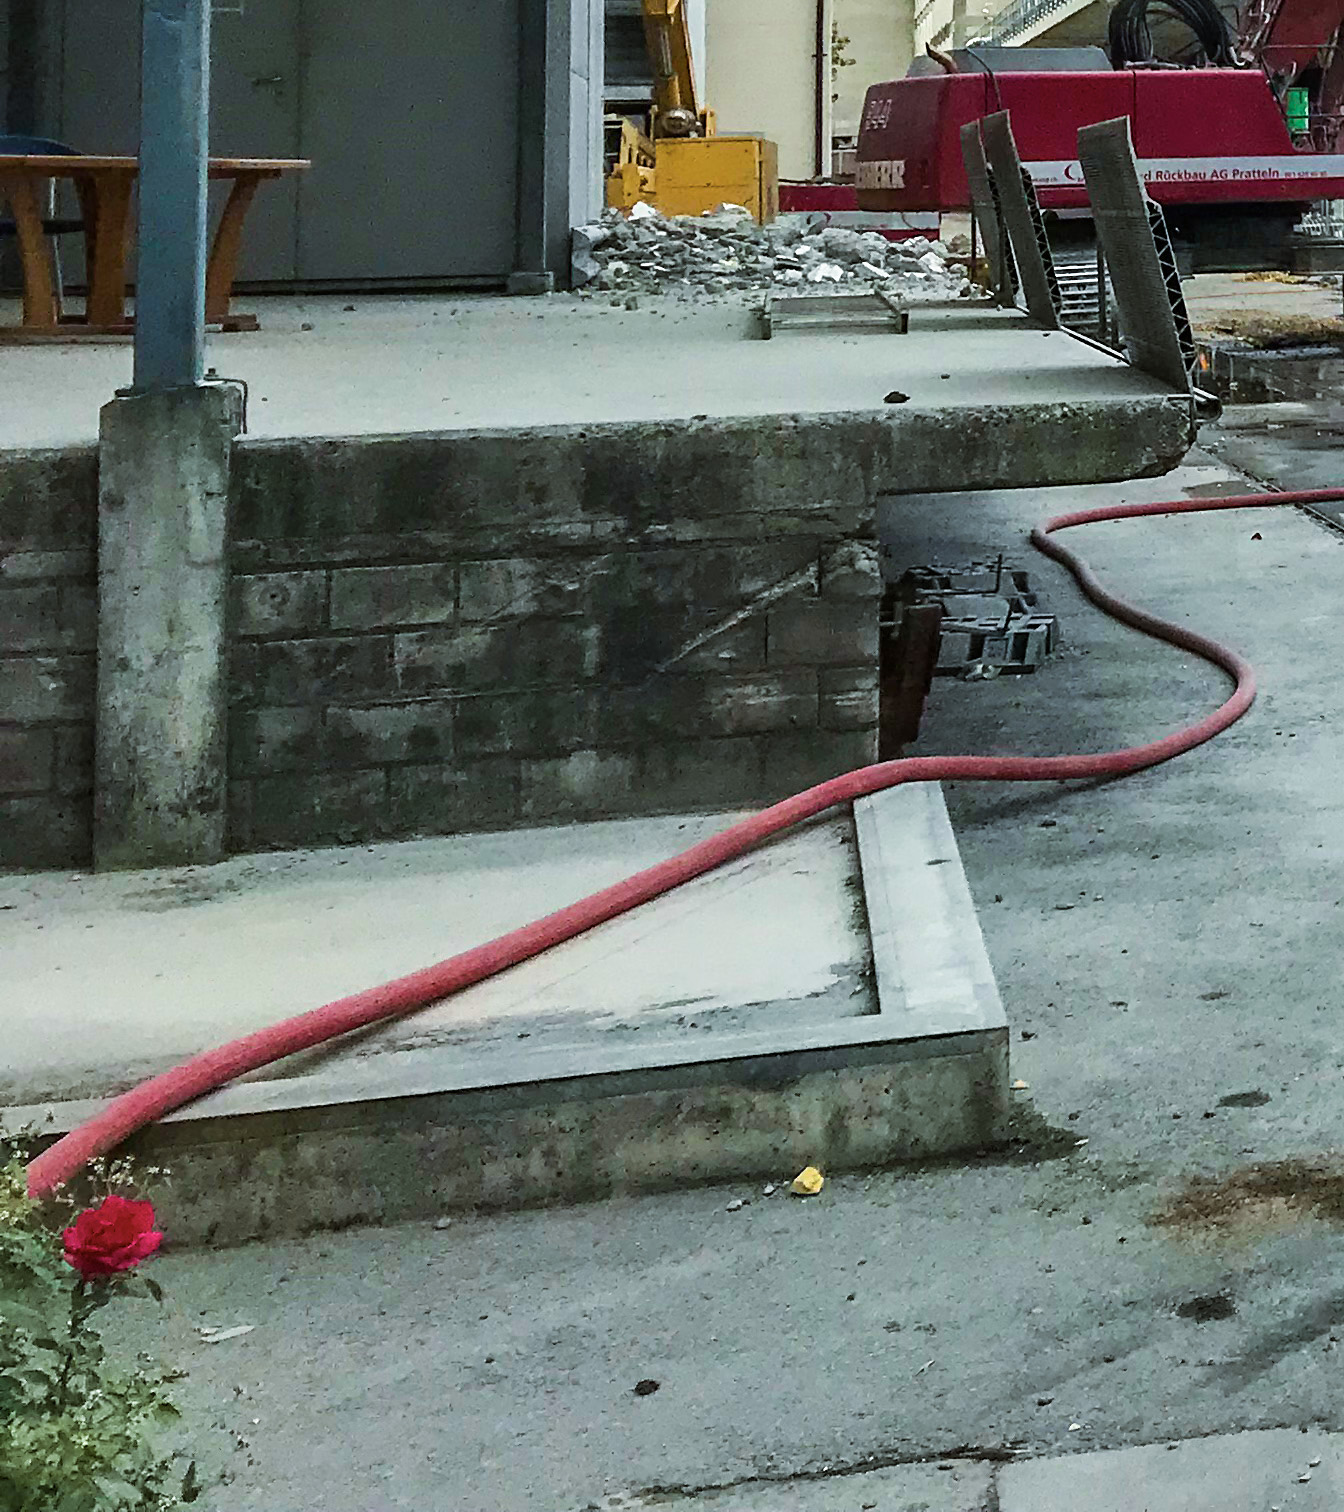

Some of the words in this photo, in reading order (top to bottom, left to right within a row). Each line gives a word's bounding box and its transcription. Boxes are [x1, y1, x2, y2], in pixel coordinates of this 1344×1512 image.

[1156, 169, 1206, 181] Rückbau
[1211, 169, 1228, 180] AG
[1232, 168, 1280, 179] Pratteln
